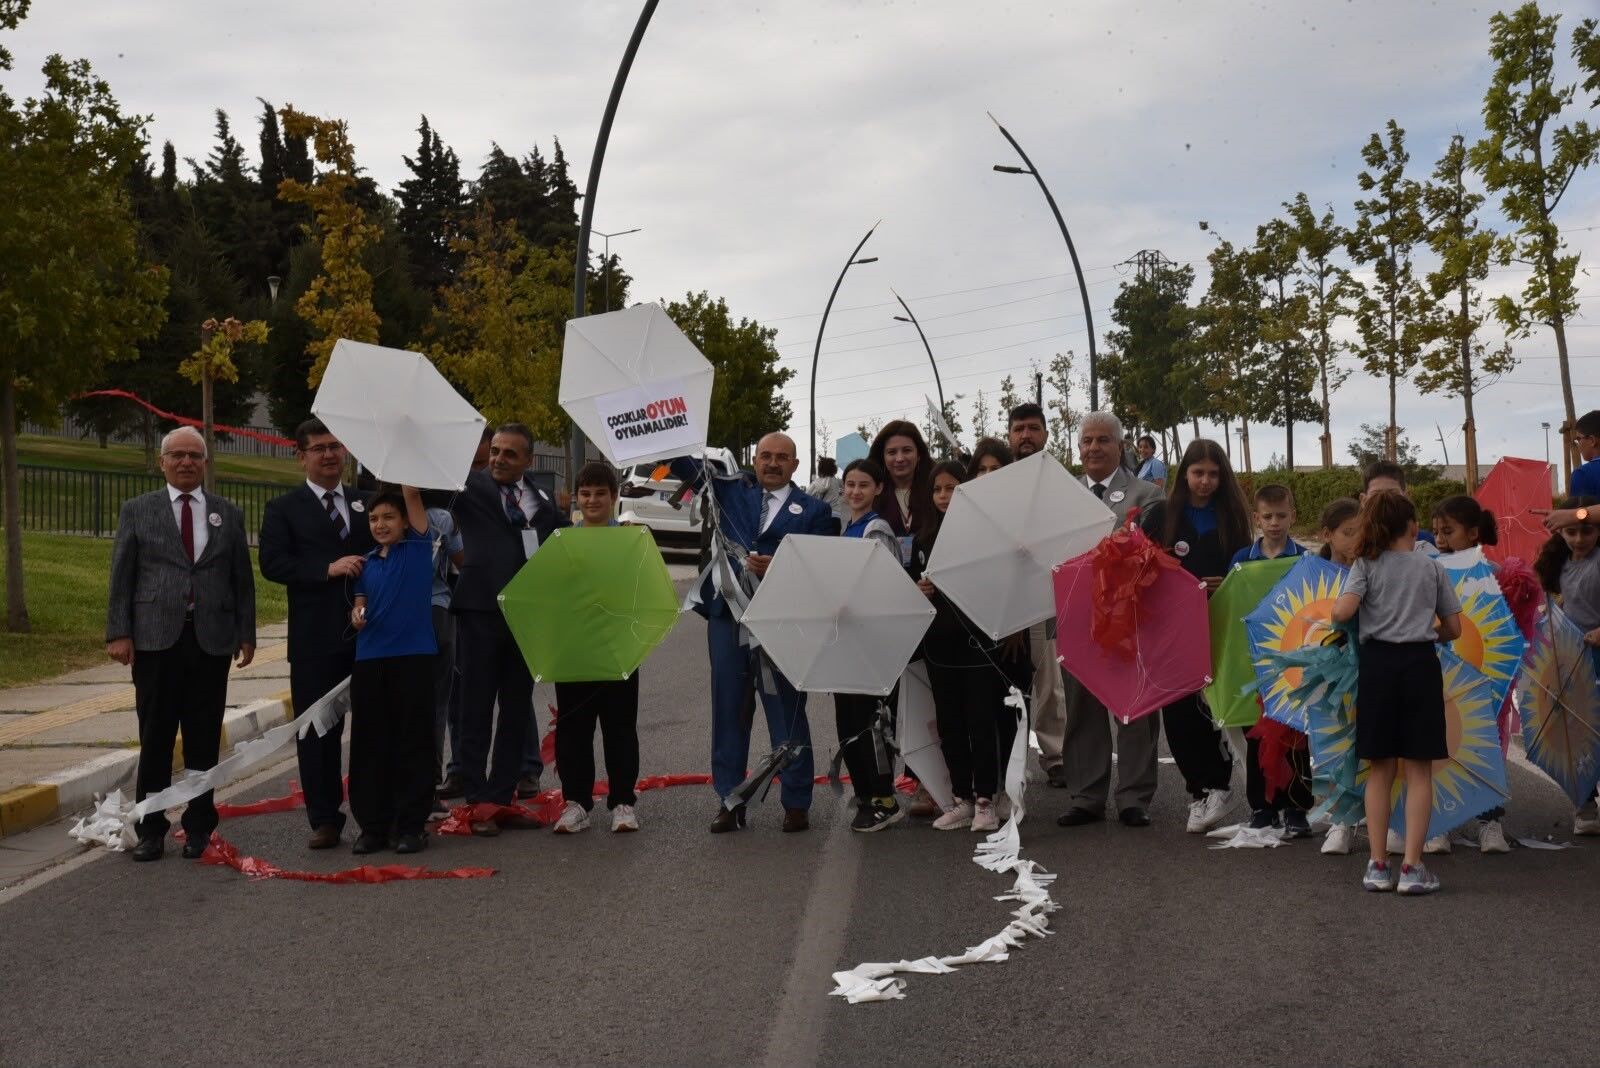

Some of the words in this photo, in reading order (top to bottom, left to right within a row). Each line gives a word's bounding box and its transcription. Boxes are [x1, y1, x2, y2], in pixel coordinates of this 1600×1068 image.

[607, 408, 647, 429] ÇOCUKLAR
[646, 397, 687, 419] OYUN
[615, 414, 688, 440] OYNAMALIDIR!
